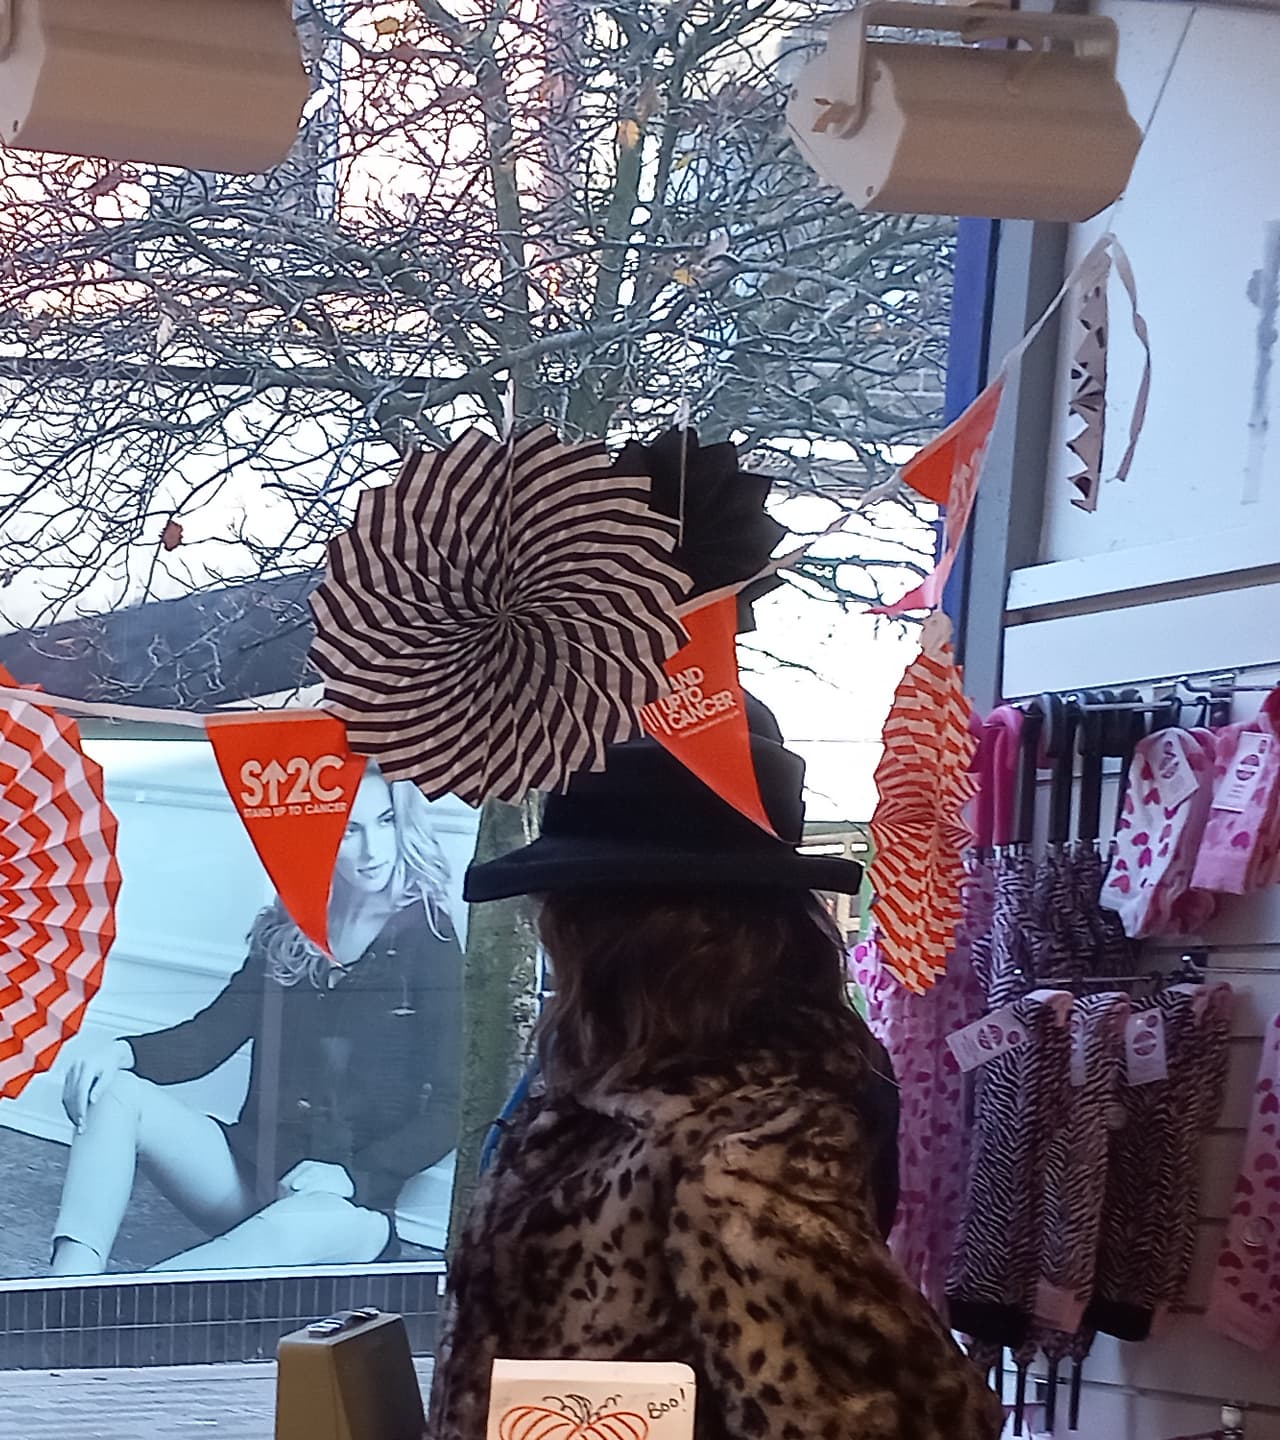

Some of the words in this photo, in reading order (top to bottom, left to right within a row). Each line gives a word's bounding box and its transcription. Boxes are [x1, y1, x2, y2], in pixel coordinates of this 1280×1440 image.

[669, 667, 704, 692] AND
[668, 691, 737, 730] CANCER
[647, 1387, 687, 1419] Boo!
